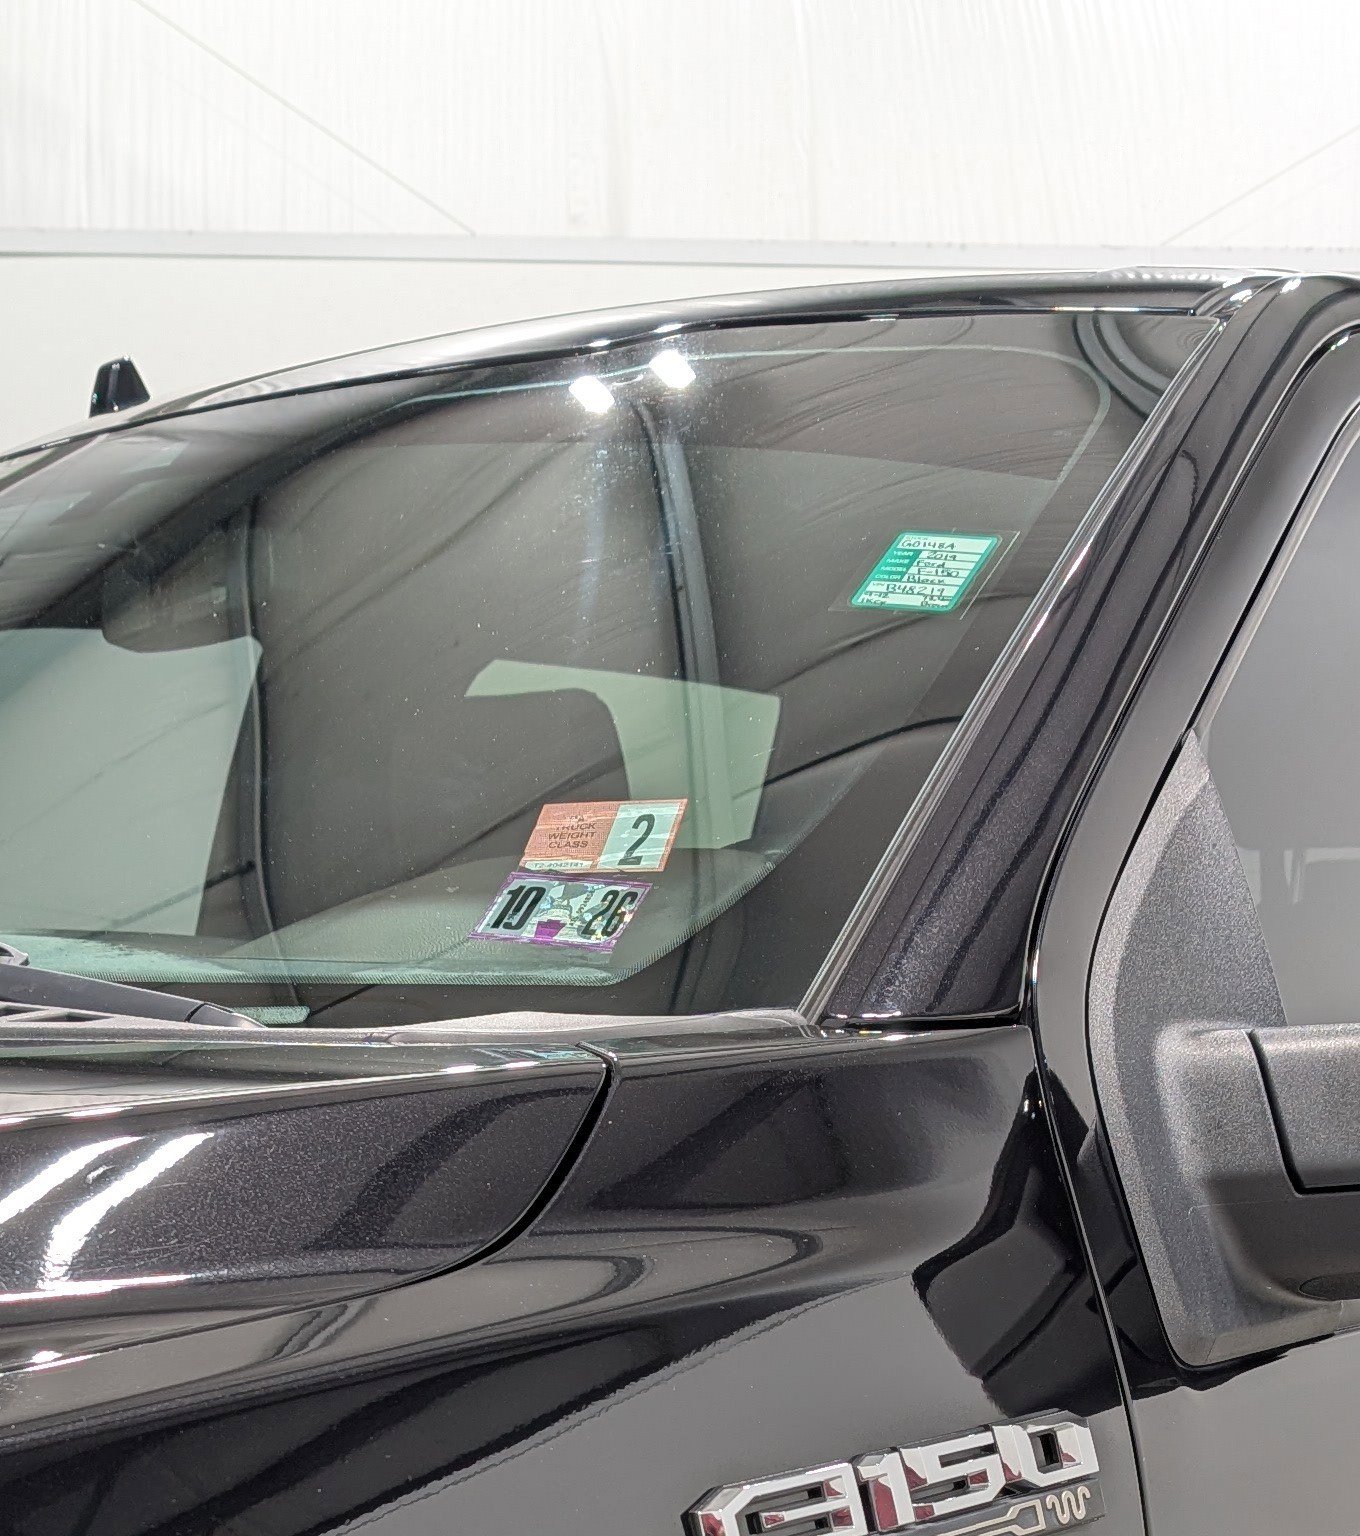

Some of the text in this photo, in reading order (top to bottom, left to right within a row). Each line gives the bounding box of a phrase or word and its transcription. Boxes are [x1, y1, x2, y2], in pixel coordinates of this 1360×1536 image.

[548, 831, 597, 840] WEIGHT
[548, 840, 589, 849] CLASS
[617, 813, 655, 866] 2
[581, 889, 639, 937] 26
